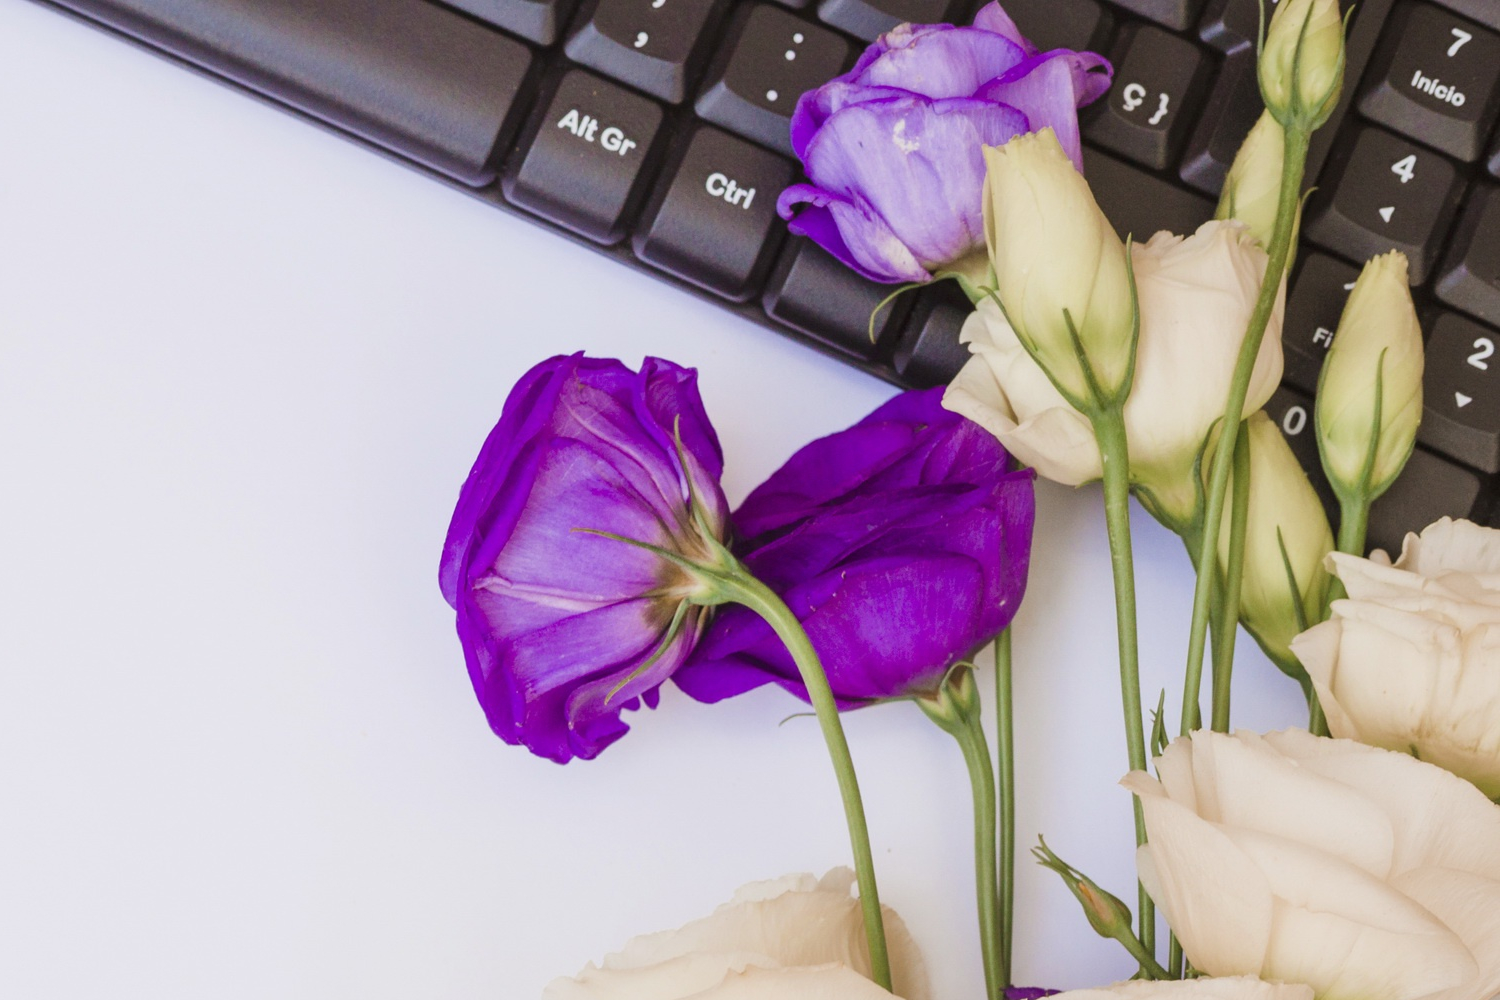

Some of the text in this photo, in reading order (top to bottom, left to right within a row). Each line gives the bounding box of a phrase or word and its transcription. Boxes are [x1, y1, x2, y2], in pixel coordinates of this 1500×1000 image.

[1446, 27, 1472, 58] 7
[557, 109, 637, 157] Alt Gr
[1391, 154, 1417, 184] 4
[705, 172, 756, 210] Ctrl
[1312, 326, 1334, 349] Fi
[1467, 337, 1495, 371] 2
[1282, 405, 1308, 436] 0
